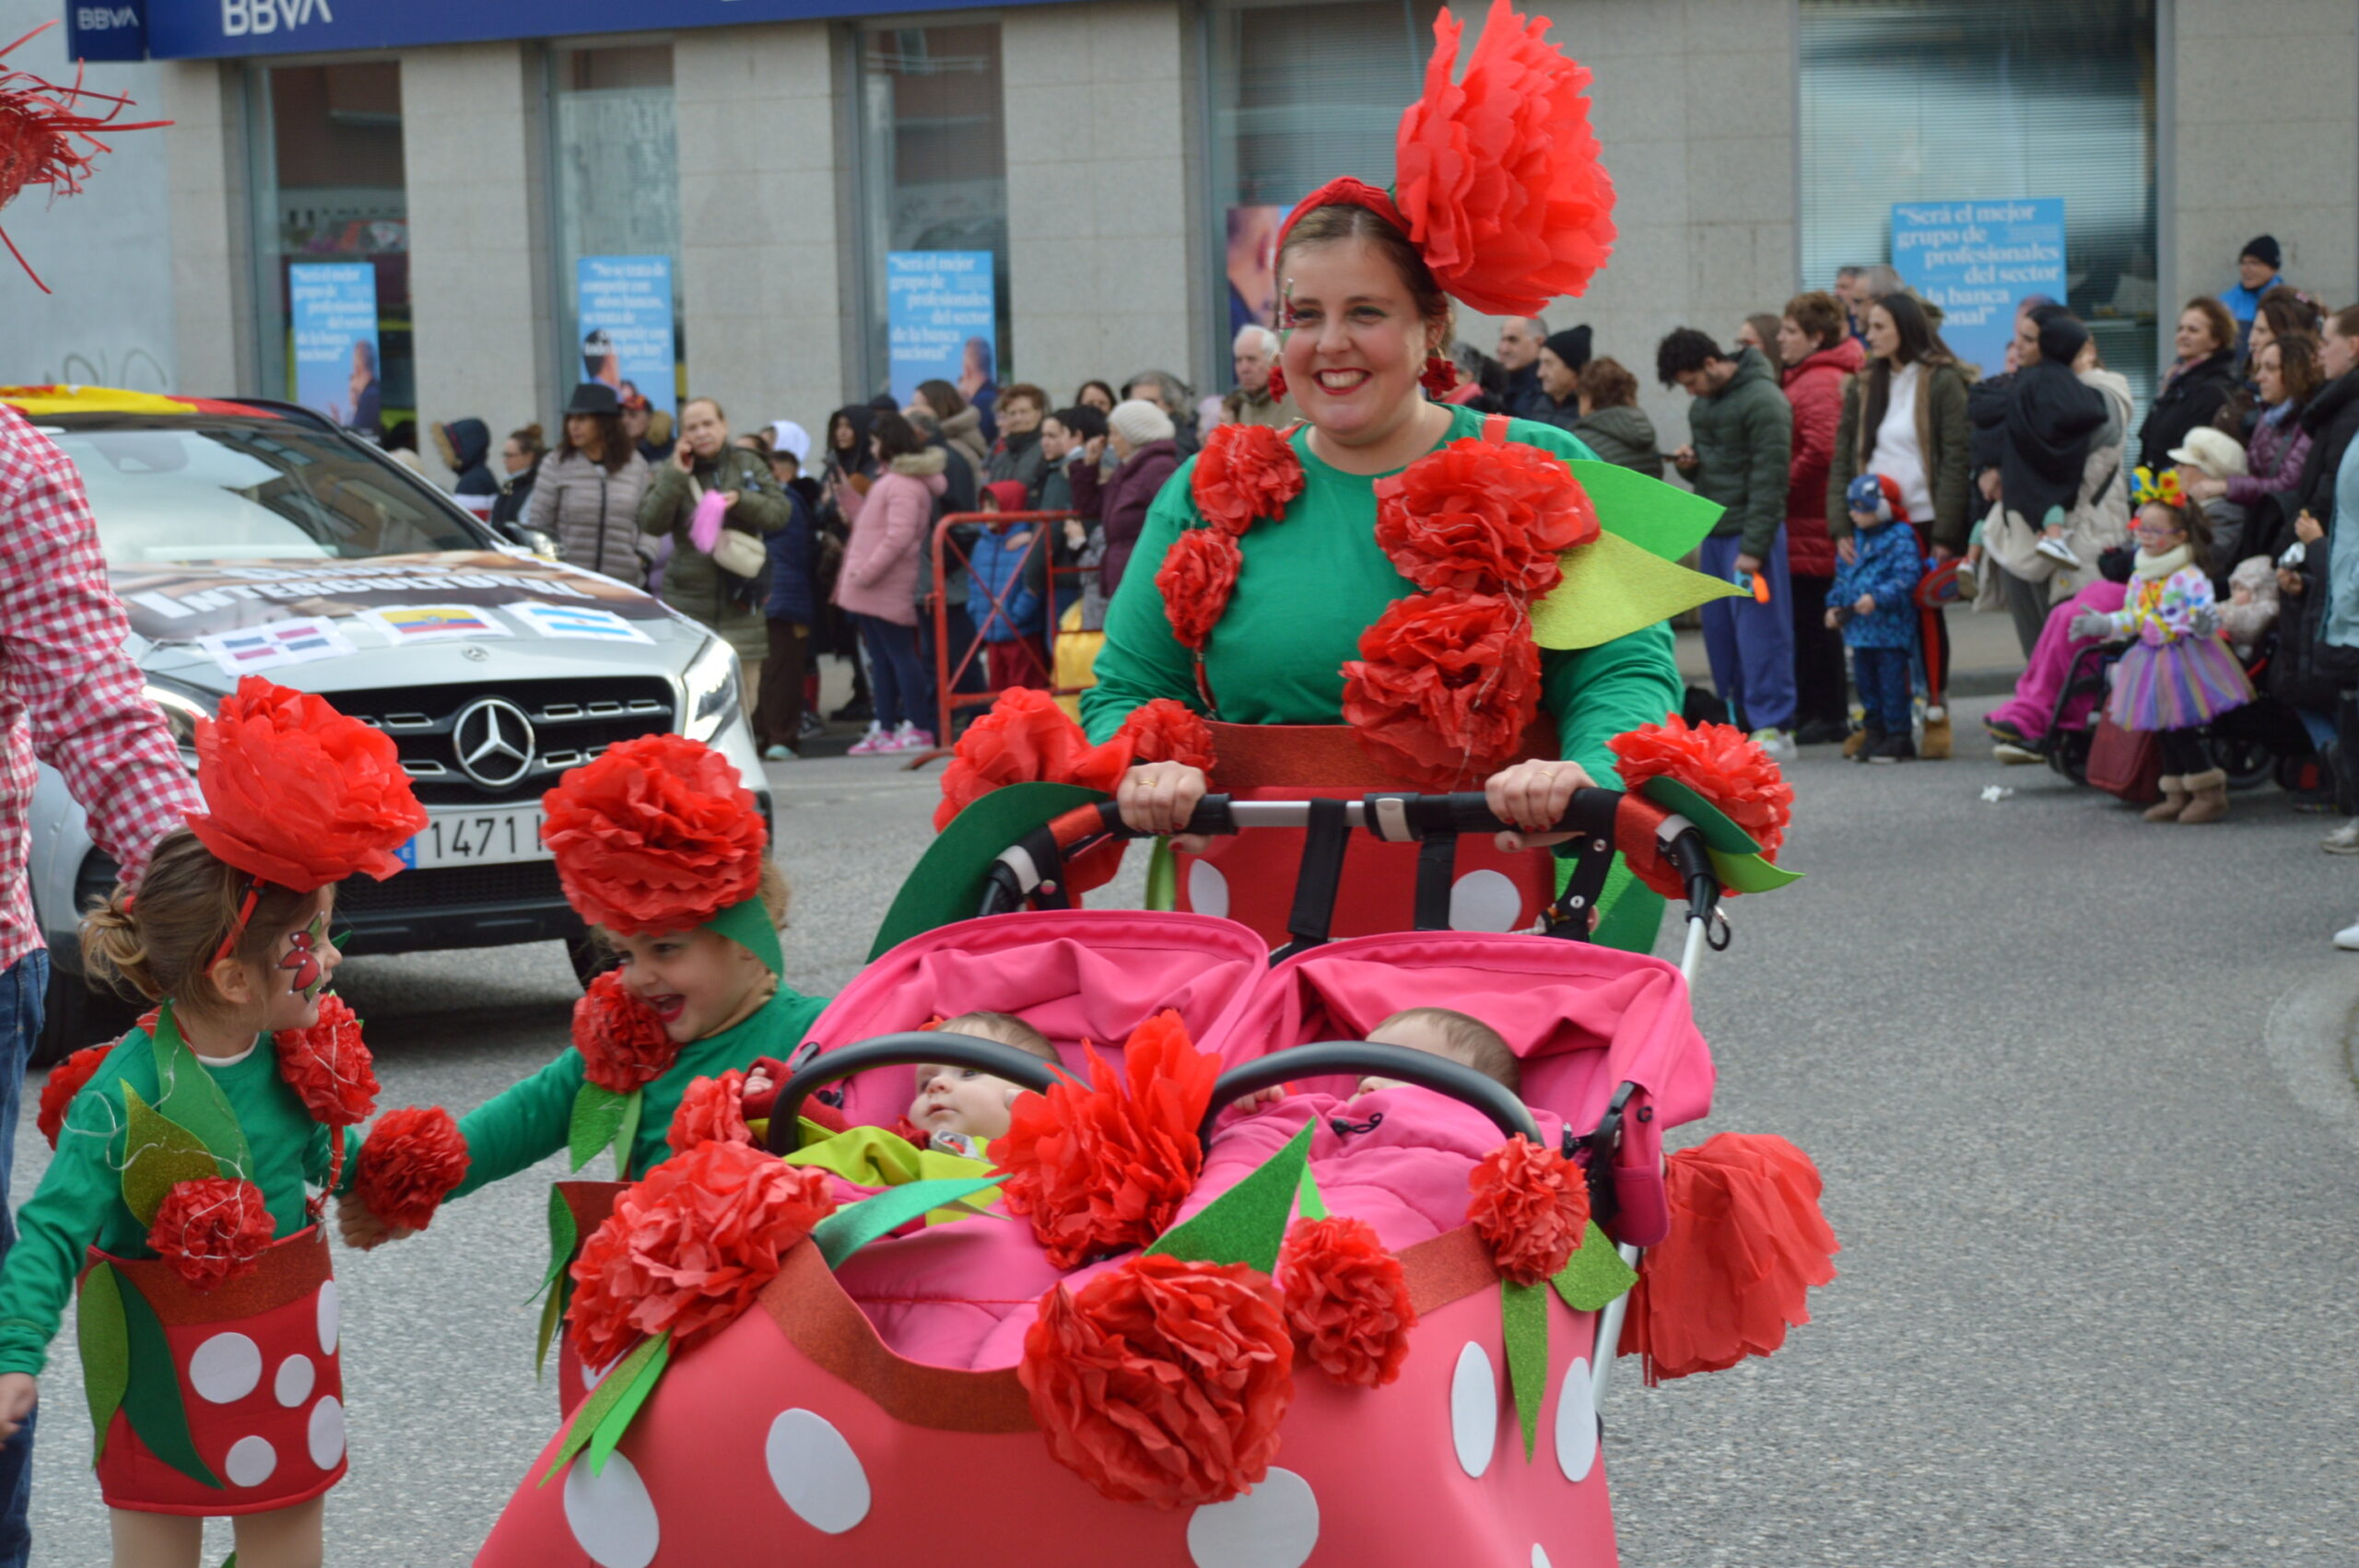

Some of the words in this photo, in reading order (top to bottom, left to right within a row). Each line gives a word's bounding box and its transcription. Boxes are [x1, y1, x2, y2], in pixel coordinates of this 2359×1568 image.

[77, 7, 138, 29] BBVA
[221, 0, 333, 36] BBVA
[1954, 204, 1973, 223] el
[1977, 201, 2036, 223] mejor
[1897, 230, 1959, 251] grupo
[1962, 224, 1988, 242] de
[1924, 241, 2060, 270] profesionales
[1964, 264, 1995, 284] del
[1999, 265, 2060, 281] sector
[1948, 287, 2010, 305] banca
[429, 815, 517, 860] 1471
